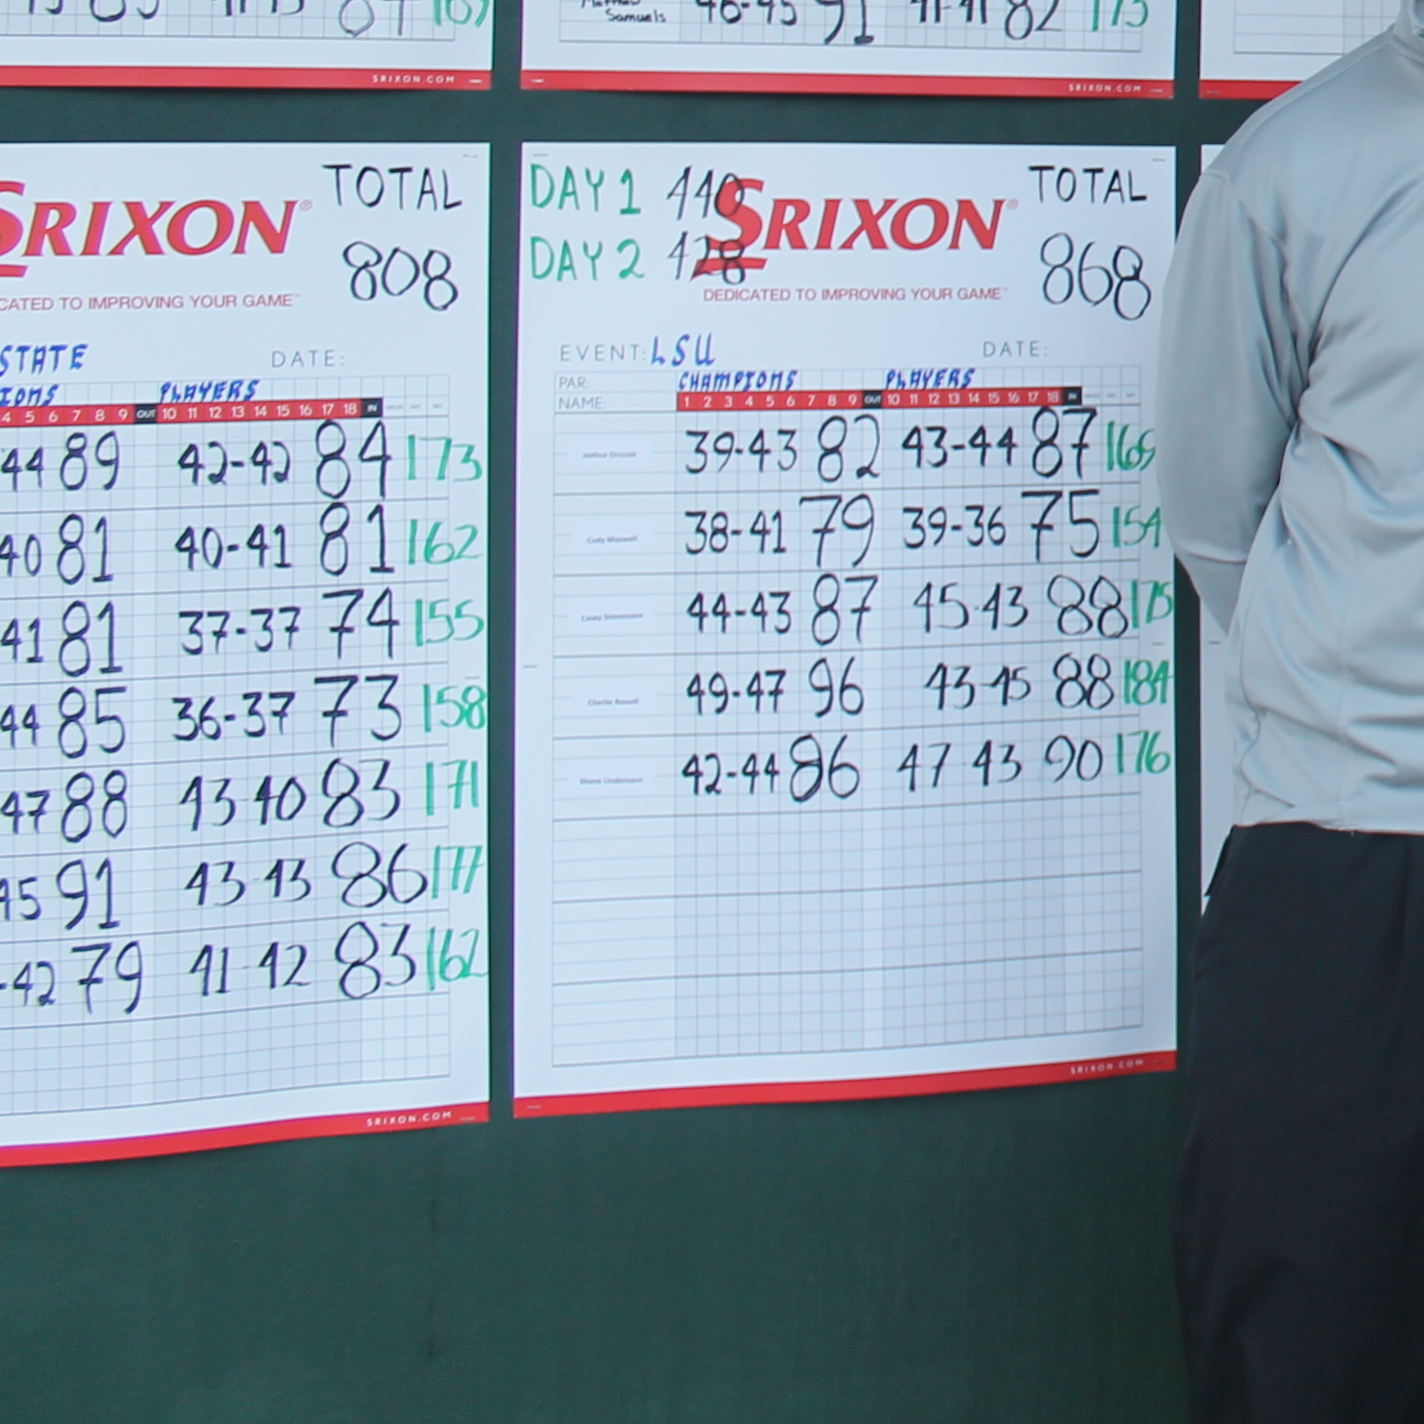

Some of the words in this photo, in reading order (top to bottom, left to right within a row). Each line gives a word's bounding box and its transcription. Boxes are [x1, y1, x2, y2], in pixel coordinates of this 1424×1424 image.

[606, 7, 667, 24] Samuels
[373, 74, 455, 85] SRIXON.COM
[1068, 83, 1142, 93] SRIXON.COM
[323, 164, 462, 210] TOTAL
[531, 164, 604, 213] DAY
[619, 164, 641, 216] 1
[1029, 165, 1147, 203] TOTAL
[690, 178, 1005, 282] SRIXON
[531, 238, 604, 280] DAY
[616, 239, 645, 278] 2
[342, 241, 458, 311] 808
[1040, 232, 1151, 321] 868
[703, 288, 791, 302] DEDICATED
[796, 288, 816, 301] TO
[821, 287, 905, 302] IMPROVING
[911, 287, 953, 301] YOUR
[957, 287, 1001, 300] GAME
[271, 350, 345, 368] DATE:
[560, 343, 646, 362] EVENT:
[650, 334, 716, 366] LSU
[982, 340, 1047, 358] DATE:
[160, 379, 260, 403] PLAYERS
[679, 370, 798, 391] CHAMPIONS
[885, 369, 974, 389] PLAYERS
[887, 394, 900, 405] 10
[686, 429, 798, 475] 39-43
[818, 415, 880, 482] 82
[902, 425, 1018, 470] 43-44
[1032, 406, 1096, 478] 87
[685, 511, 787, 555] 38-41
[800, 494, 875, 568] 79
[902, 505, 1006, 548] 39-36
[1021, 489, 1100, 563] 75
[58, 686, 127, 758] 85
[172, 692, 295, 741] 36-37
[314, 674, 402, 747] 73
[423, 683, 486, 732] 158
[1045, 735, 1103, 784] 90
[1116, 731, 1171, 774] 176
[367, 1110, 451, 1126] SRIXON.COM
